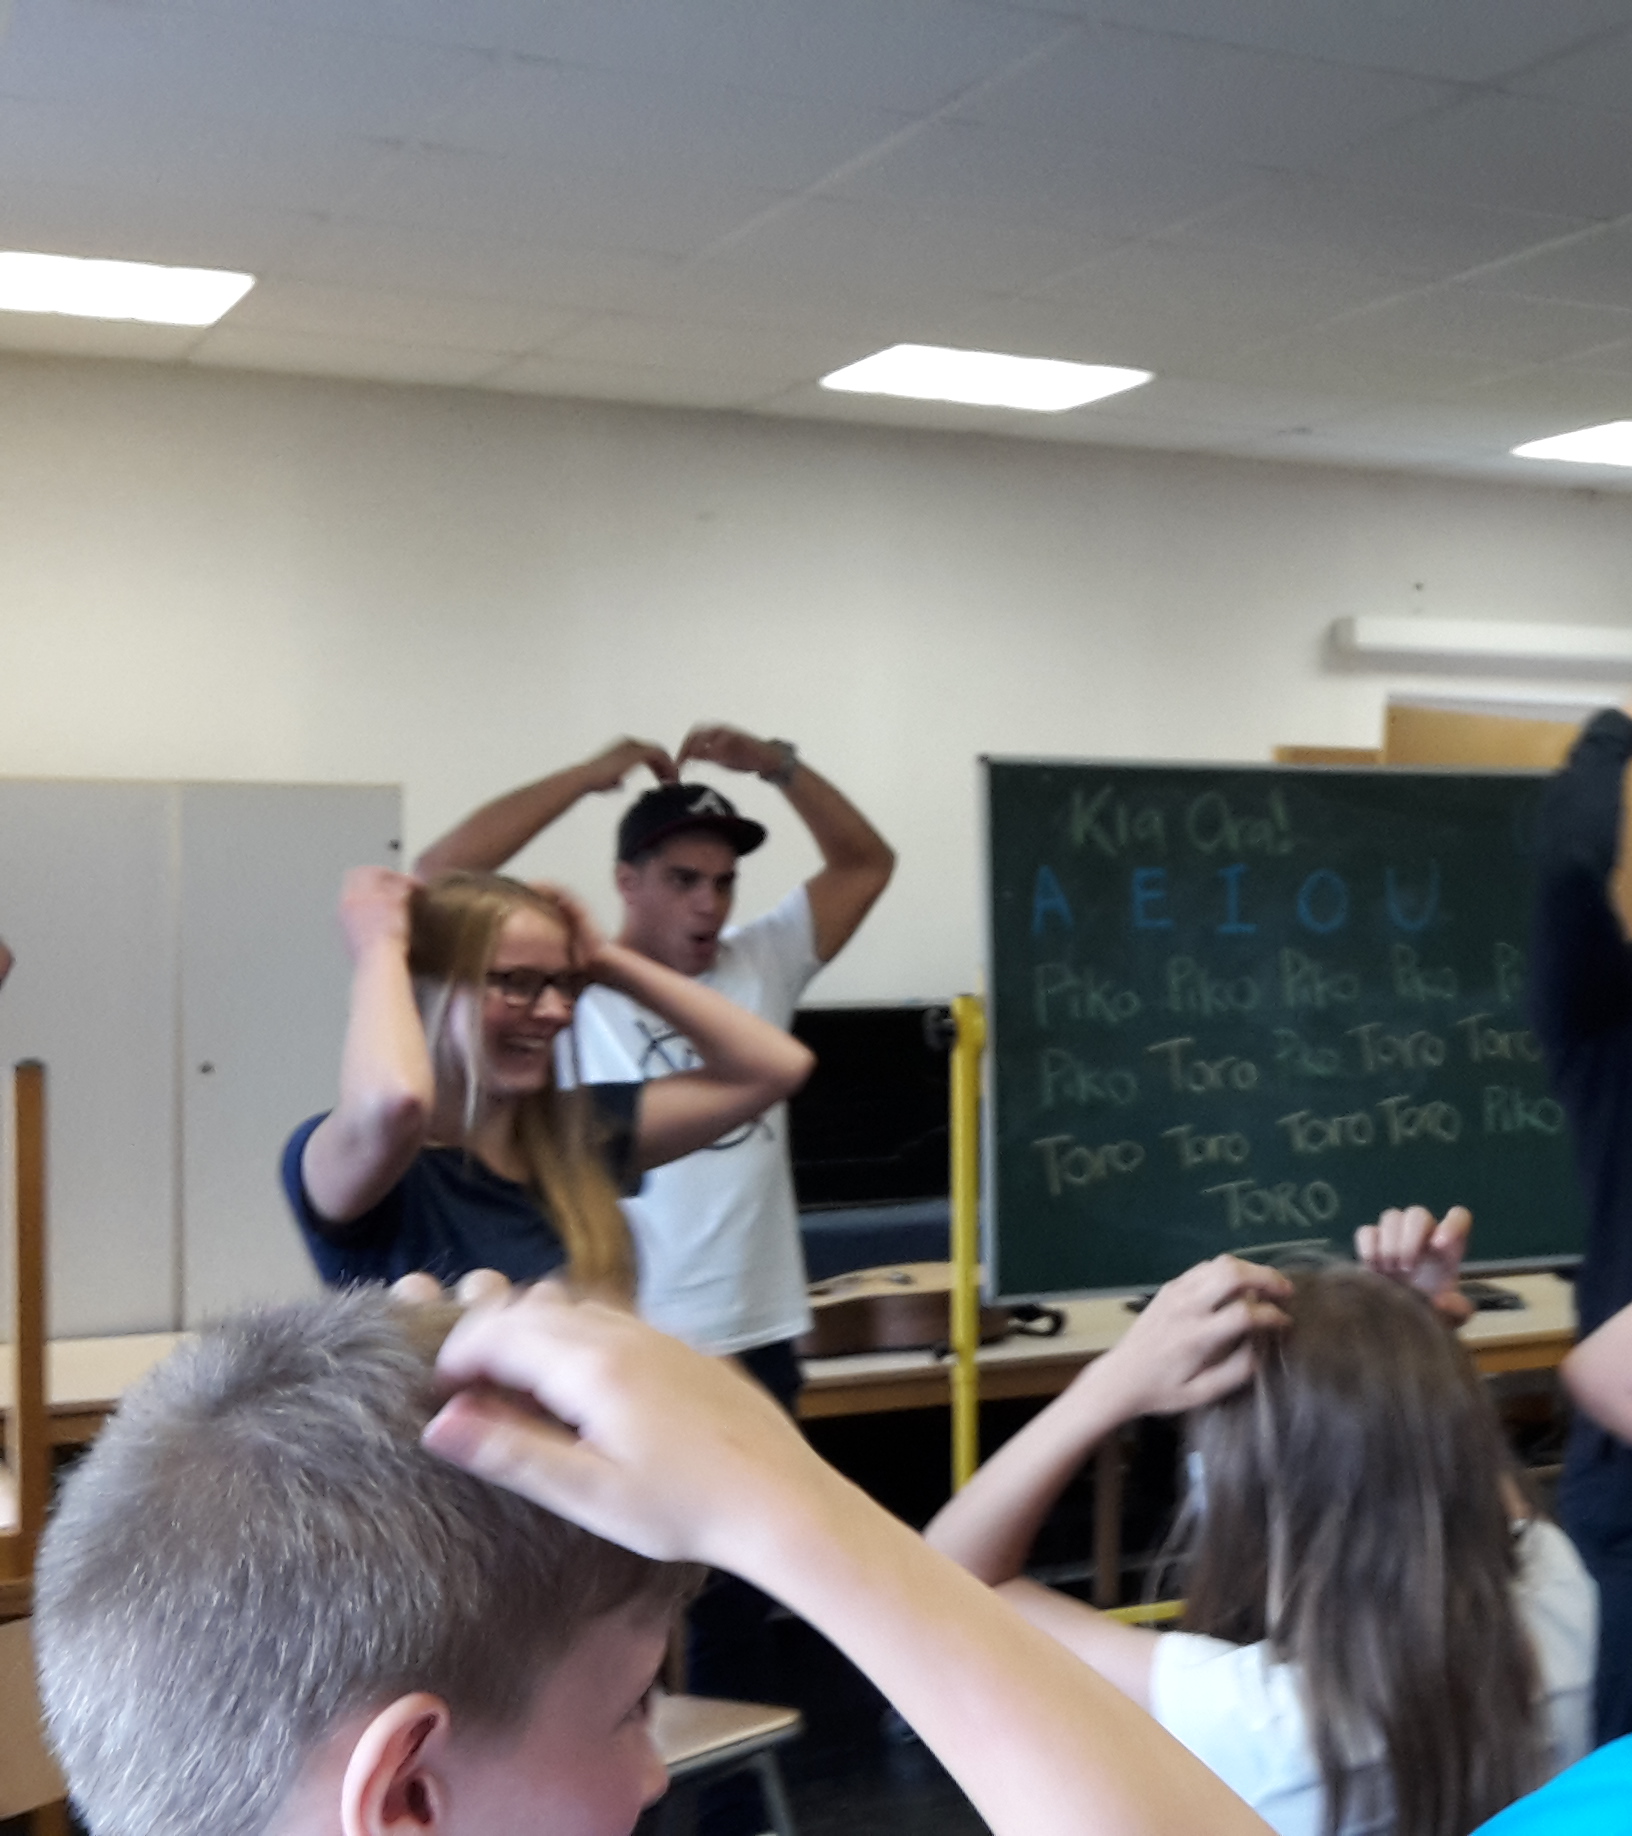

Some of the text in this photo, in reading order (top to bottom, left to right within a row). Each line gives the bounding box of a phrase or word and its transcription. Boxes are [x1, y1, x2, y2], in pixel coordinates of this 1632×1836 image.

[1031, 860, 1441, 936] A E I O U
[1034, 962, 1141, 1028] Piko
[1145, 1036, 1260, 1094] Toro
[1345, 1021, 1447, 1073] Toro
[1031, 1133, 1146, 1197] Toro
[1160, 1124, 1251, 1169] Toro
[1276, 1109, 1376, 1155] Toro
